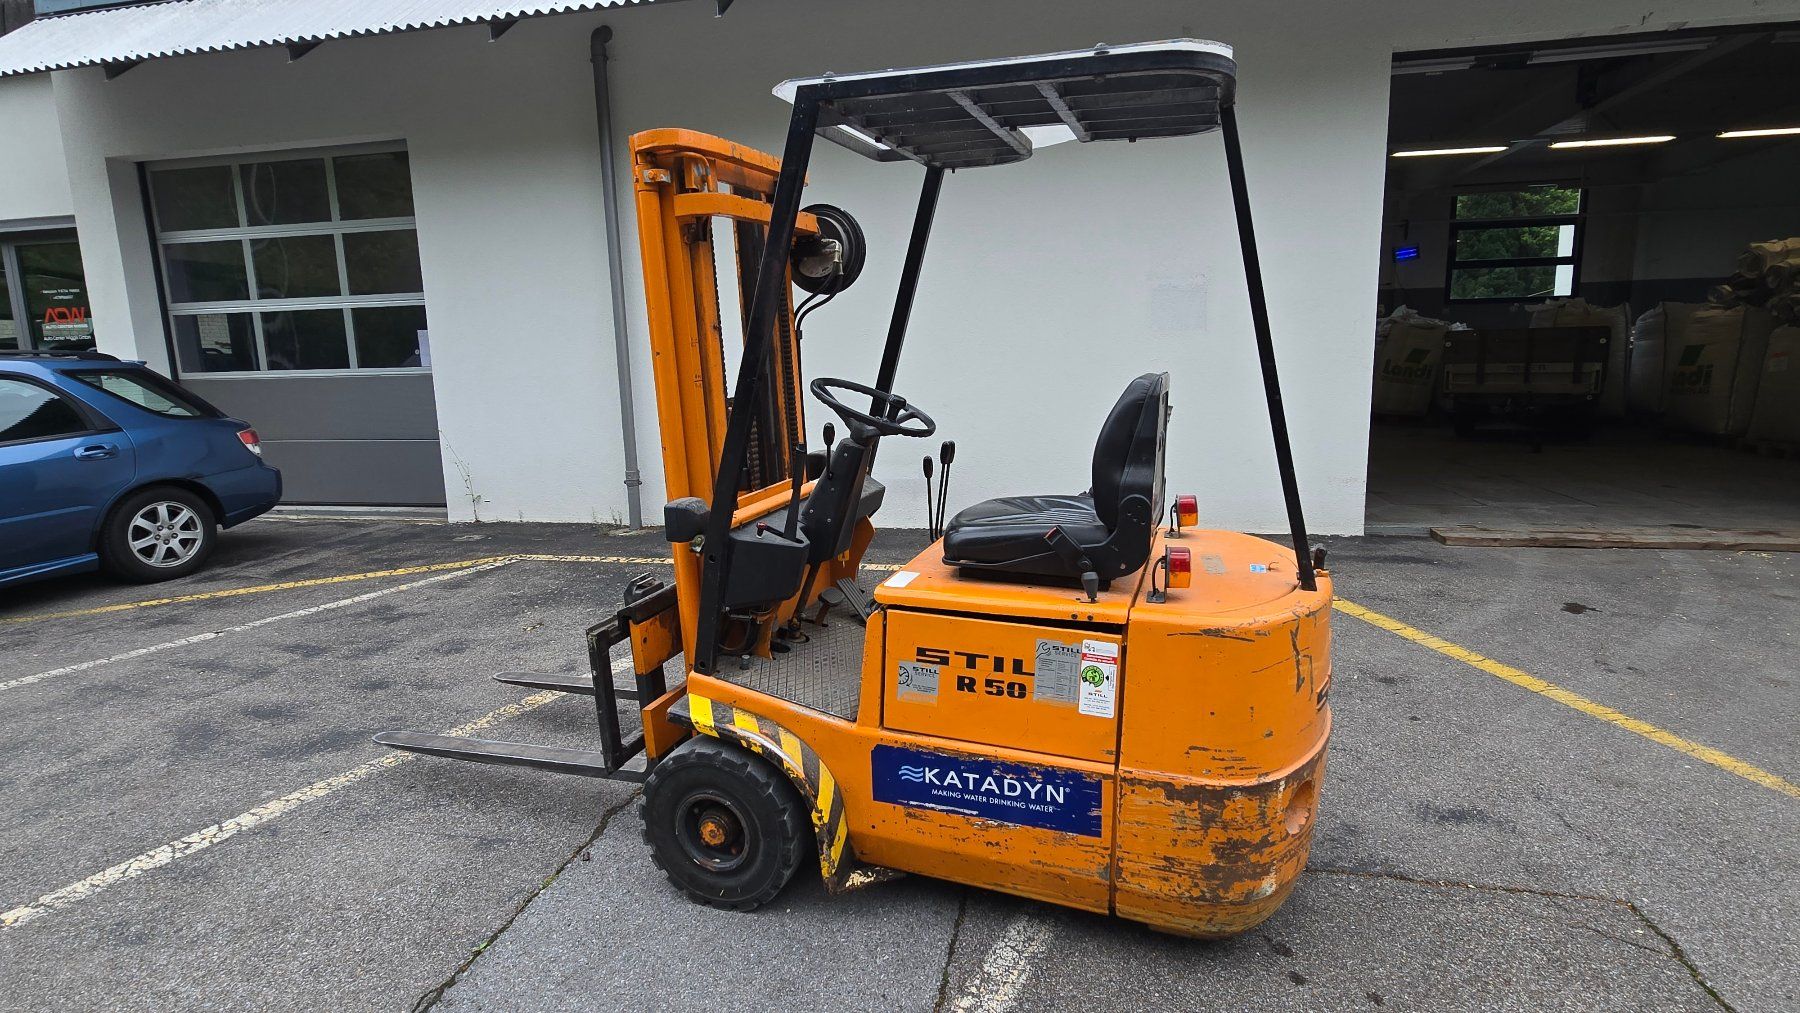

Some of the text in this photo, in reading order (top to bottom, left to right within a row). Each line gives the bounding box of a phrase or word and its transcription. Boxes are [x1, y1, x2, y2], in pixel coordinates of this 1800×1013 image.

[915, 646, 1035, 677] STIL
[1052, 645, 1081, 654] STILL
[912, 666, 940, 675] STILL
[956, 674, 976, 693] R
[984, 679, 1027, 699] 50
[931, 788, 1054, 814] MAKING WATER DRINKING WATER
